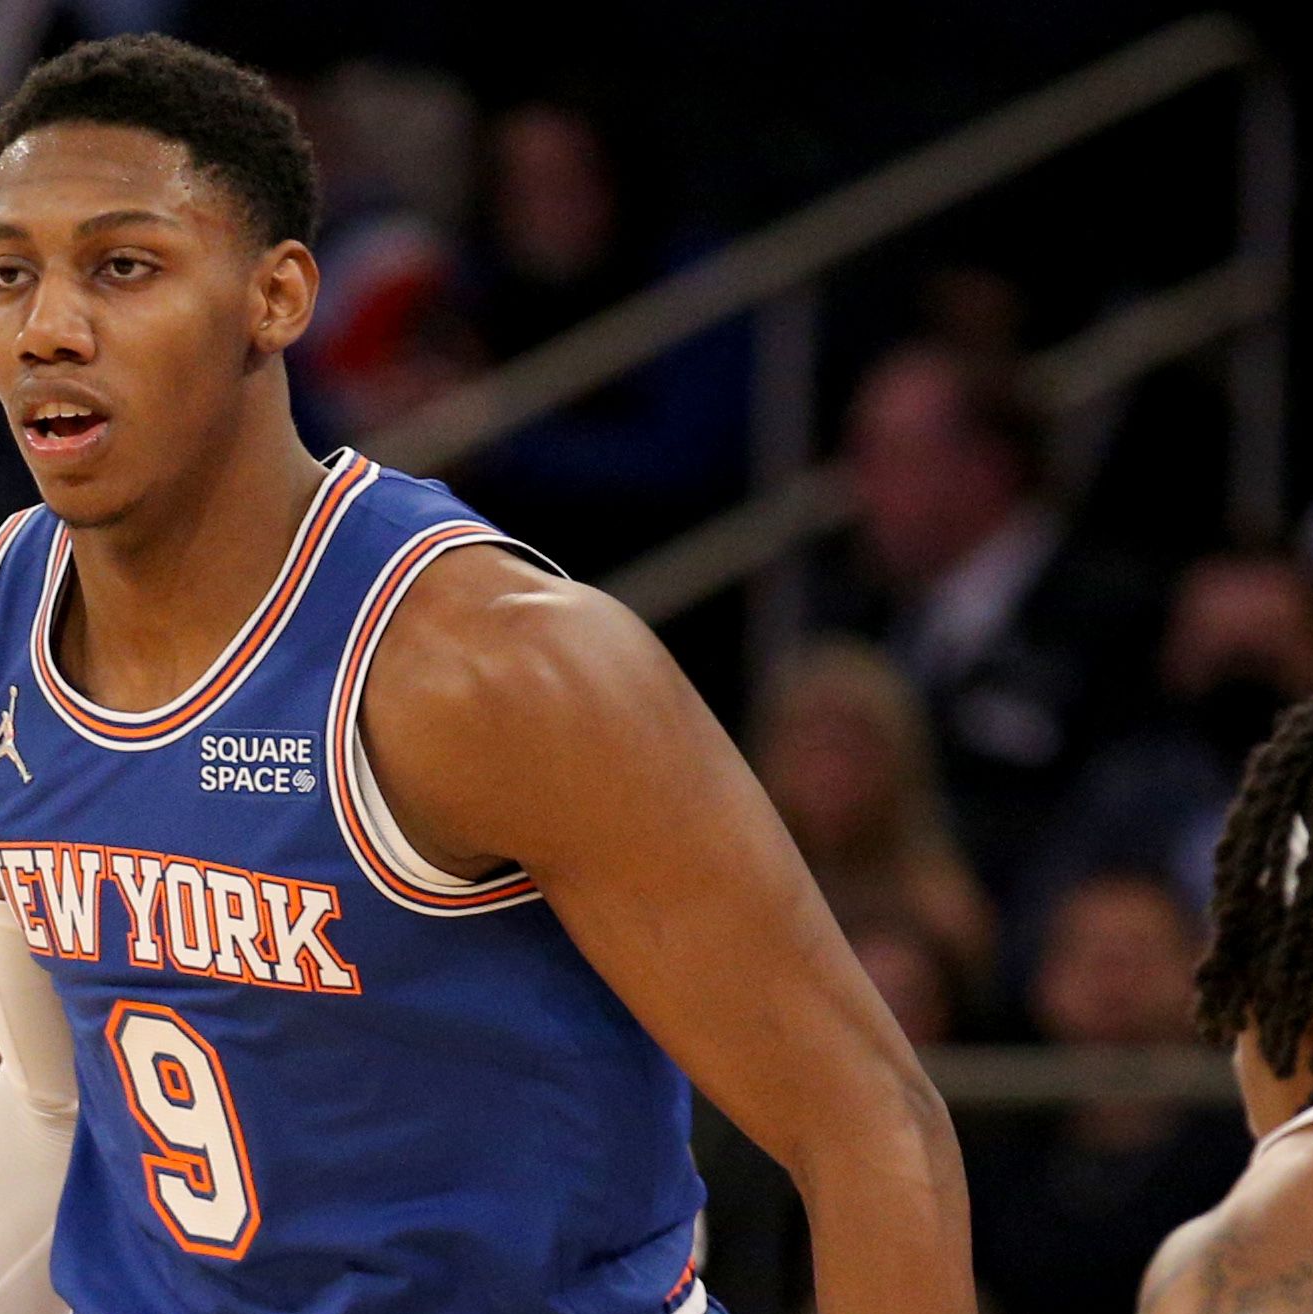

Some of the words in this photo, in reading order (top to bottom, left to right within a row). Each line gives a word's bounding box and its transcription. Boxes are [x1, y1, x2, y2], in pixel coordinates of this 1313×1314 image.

[200, 765, 290, 793] SPACE
[201, 735, 312, 764] SQUARE
[107, 846, 362, 995] YORK
[104, 999, 261, 1260] 9
